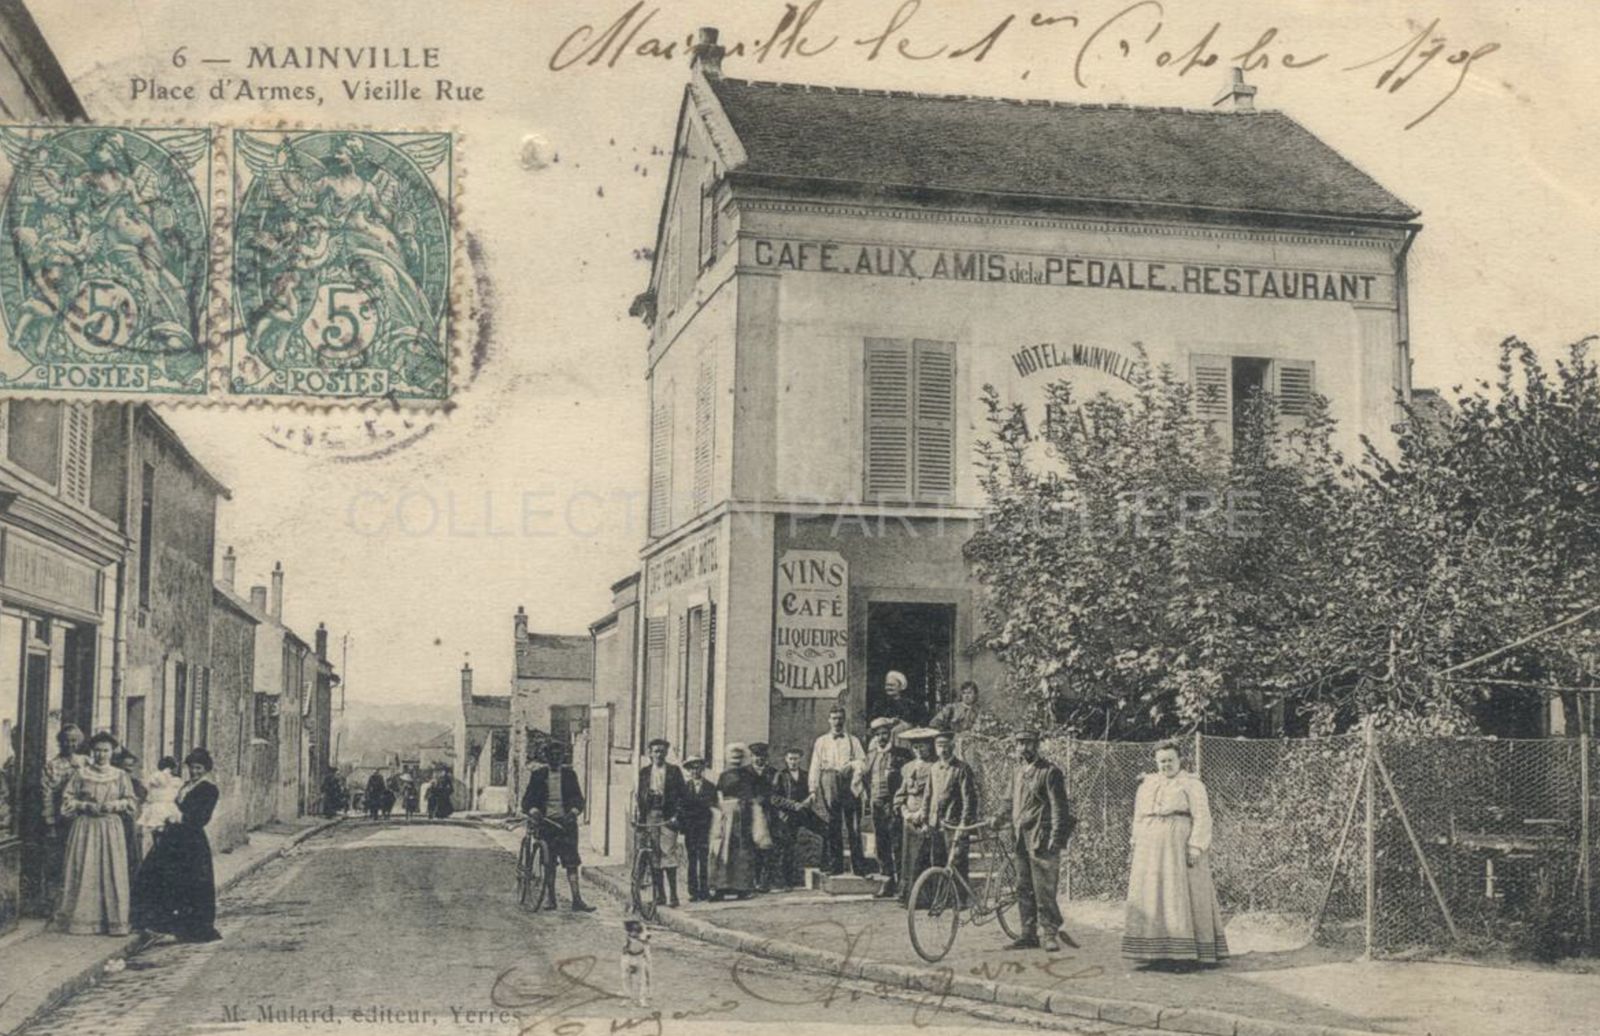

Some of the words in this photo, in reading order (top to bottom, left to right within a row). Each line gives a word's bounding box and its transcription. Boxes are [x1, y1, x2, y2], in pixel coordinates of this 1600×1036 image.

[931, 252, 1006, 283] AMIS
[1183, 266, 1377, 302] RESTAURANT
[53, 366, 145, 388] POSTES
[1011, 343, 1062, 378] HÔTEL
[1072, 343, 1139, 387] MAINVILLE
[291, 371, 385, 393] POSTES
[780, 559, 845, 587] VINS
[781, 592, 844, 617] CAFÉ
[778, 627, 850, 648] LIQUEURS
[775, 658, 846, 690] BILLARD
